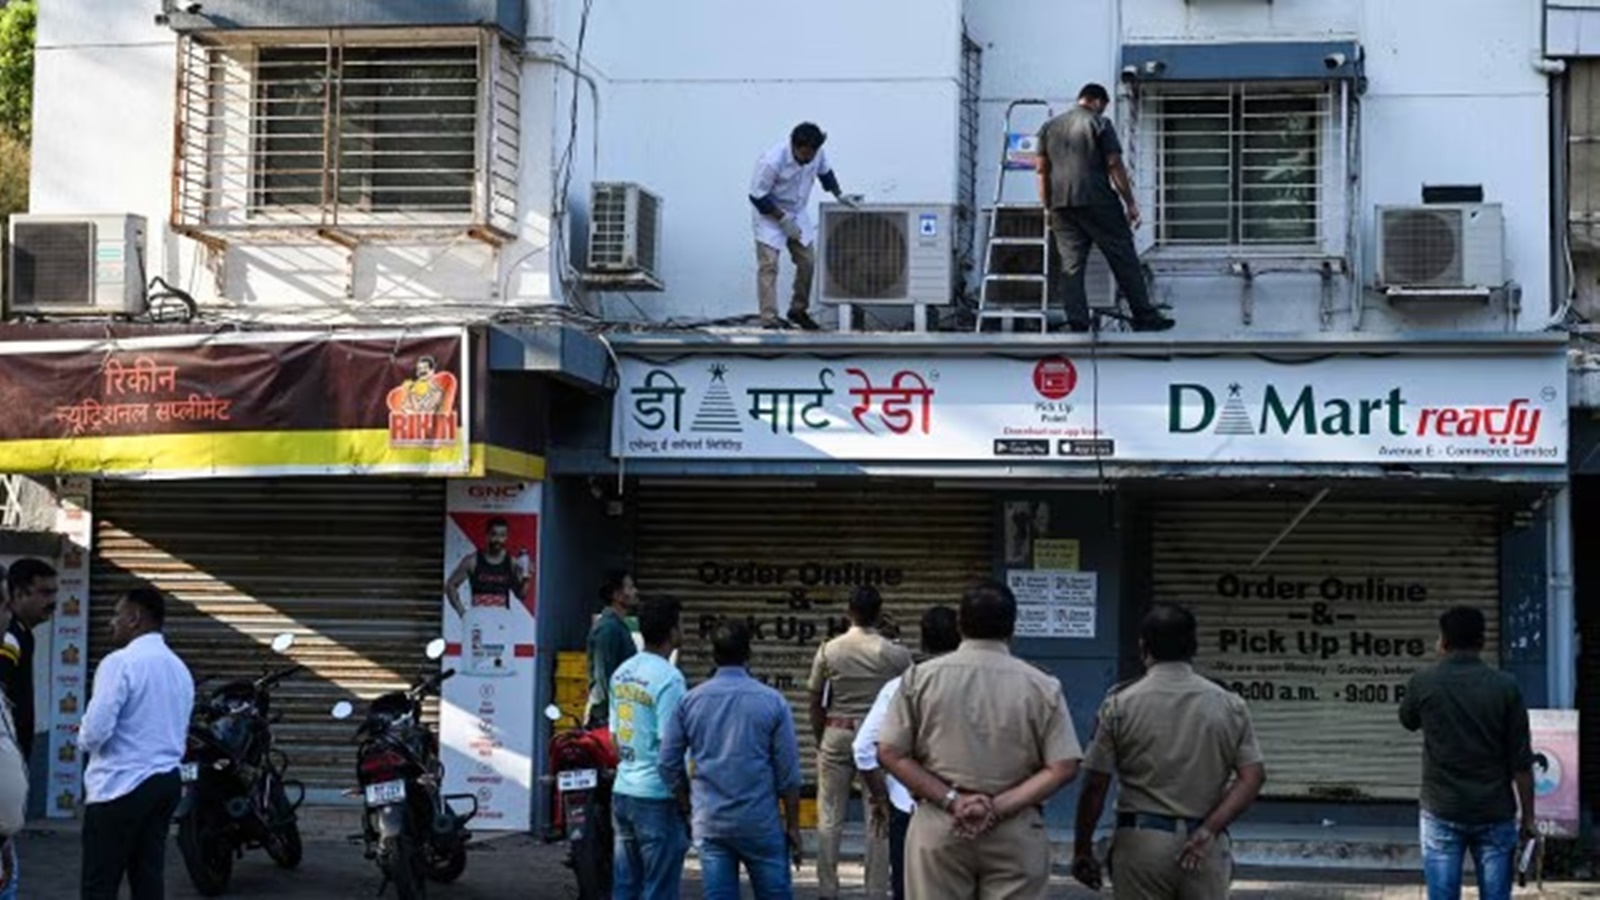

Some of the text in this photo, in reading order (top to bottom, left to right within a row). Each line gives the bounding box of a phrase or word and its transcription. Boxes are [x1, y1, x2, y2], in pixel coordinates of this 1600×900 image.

[105, 358, 178, 394] रिकीन
[631, 368, 934, 434] डी मार्ट रेडी
[1416, 399, 1541, 445] ready
[468, 485, 517, 498] GNC
[699, 561, 902, 585] Order Online
[1216, 573, 1427, 601] Order Online
[777, 616, 816, 645] Up
[1218, 629, 1426, 660] Pick Up Here
[1345, 684, 1388, 703] 9:00
